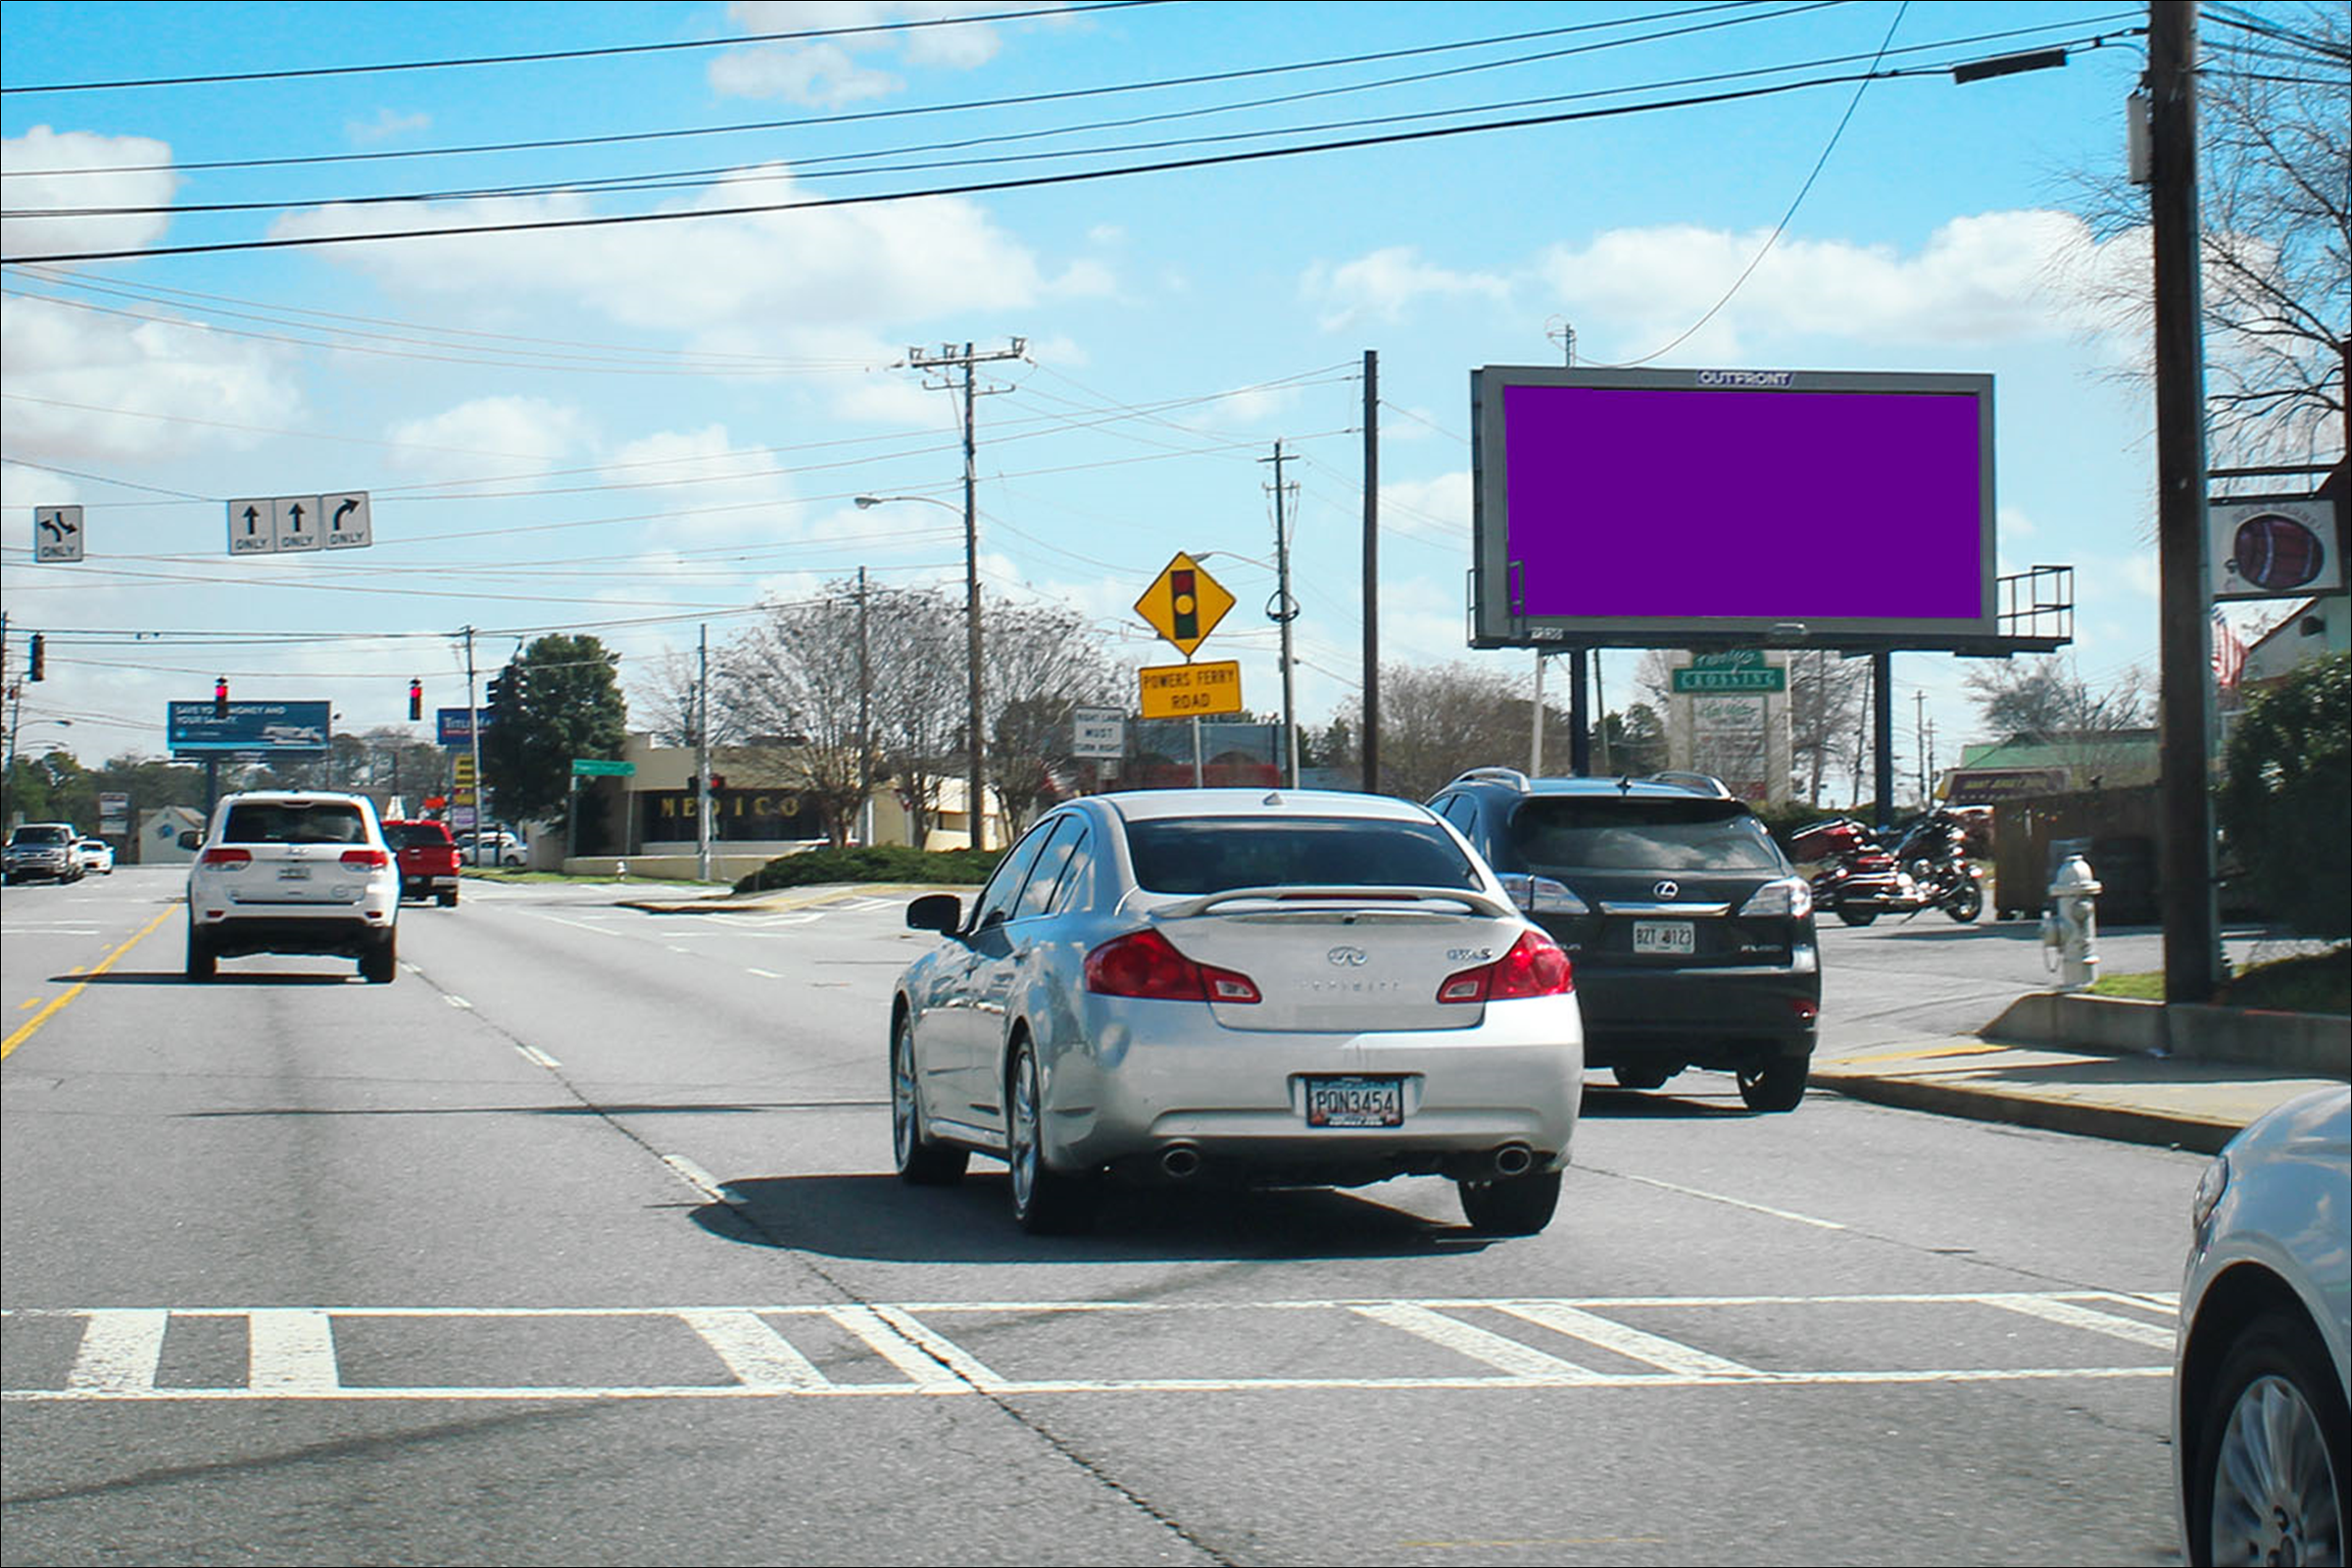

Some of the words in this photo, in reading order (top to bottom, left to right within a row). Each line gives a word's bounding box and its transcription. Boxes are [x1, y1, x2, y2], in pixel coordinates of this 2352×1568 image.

[1699, 371, 1789, 384] OUTFRONT
[235, 538, 269, 550] ONLY
[281, 536, 314, 548] ONLY
[329, 531, 364, 545] ONLY
[41, 546, 75, 558] ONLY
[1143, 671, 1191, 689] POWERS
[1197, 669, 1235, 685] FERRY
[1681, 673, 1776, 688] CROSSING
[1171, 692, 1210, 710] ROAD
[1085, 727, 1113, 739] MUST
[660, 796, 801, 817] MEDICO
